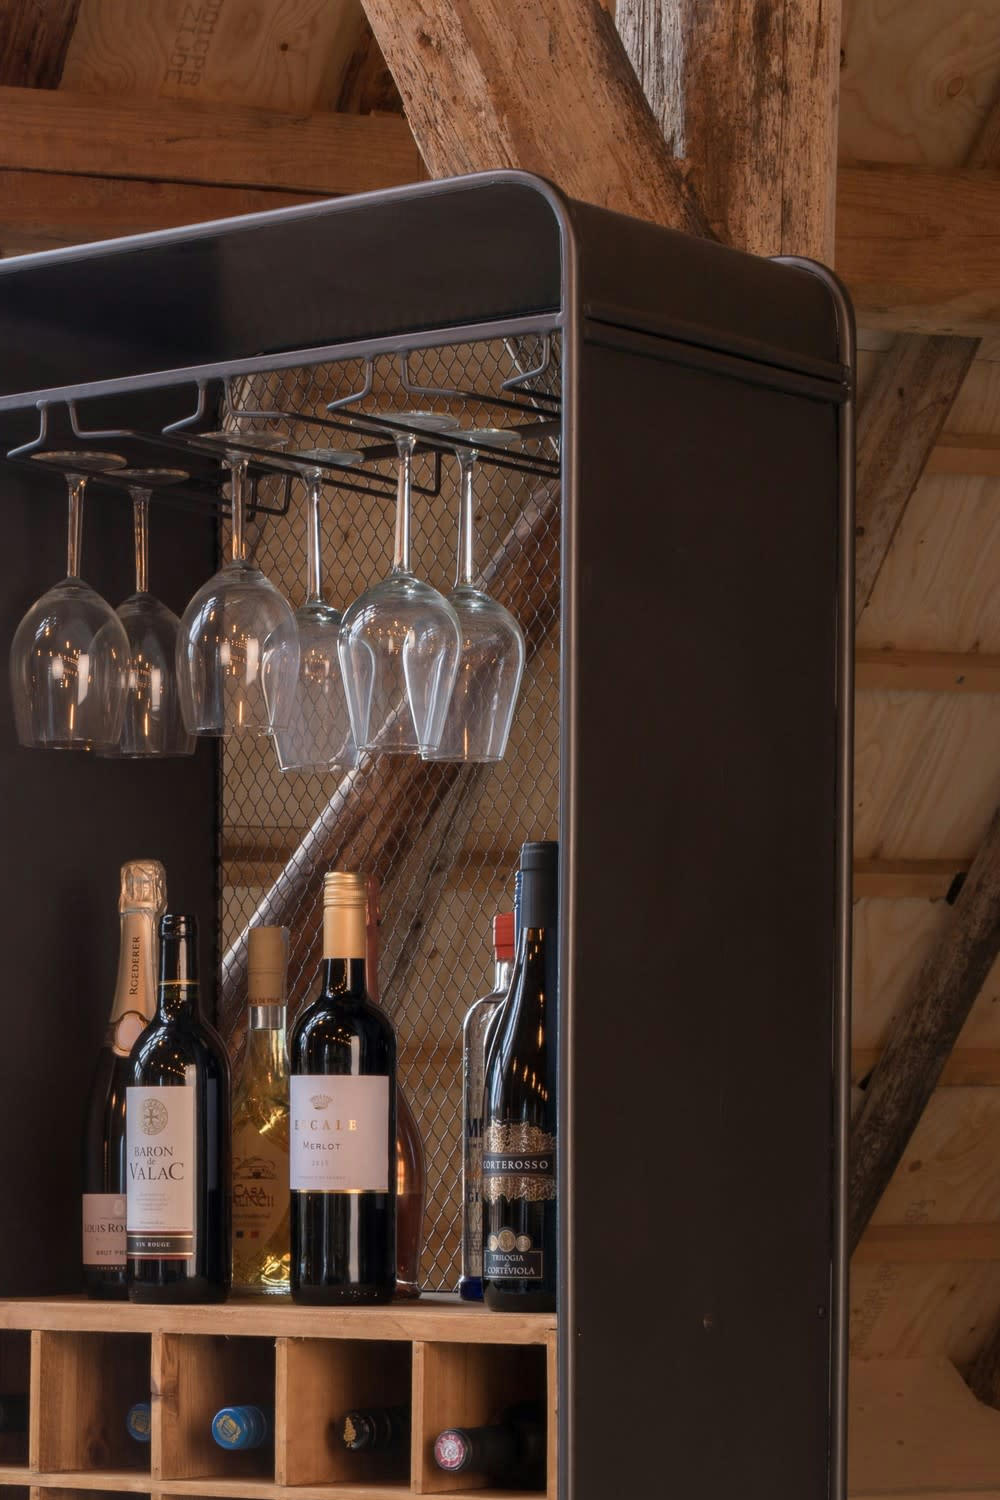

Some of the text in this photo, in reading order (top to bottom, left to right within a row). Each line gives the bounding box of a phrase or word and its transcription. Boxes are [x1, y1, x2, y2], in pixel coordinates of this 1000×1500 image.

[294, 1119, 358, 1131] ECALE
[134, 1146, 173, 1157] BARON
[147, 1157, 156, 1165] de
[483, 1160, 549, 1170] CORTEROSSO
[129, 1162, 184, 1181] VALAC
[491, 1254, 524, 1262] TRILOGIA
[487, 1266, 535, 1276] CORTEVIOLA
